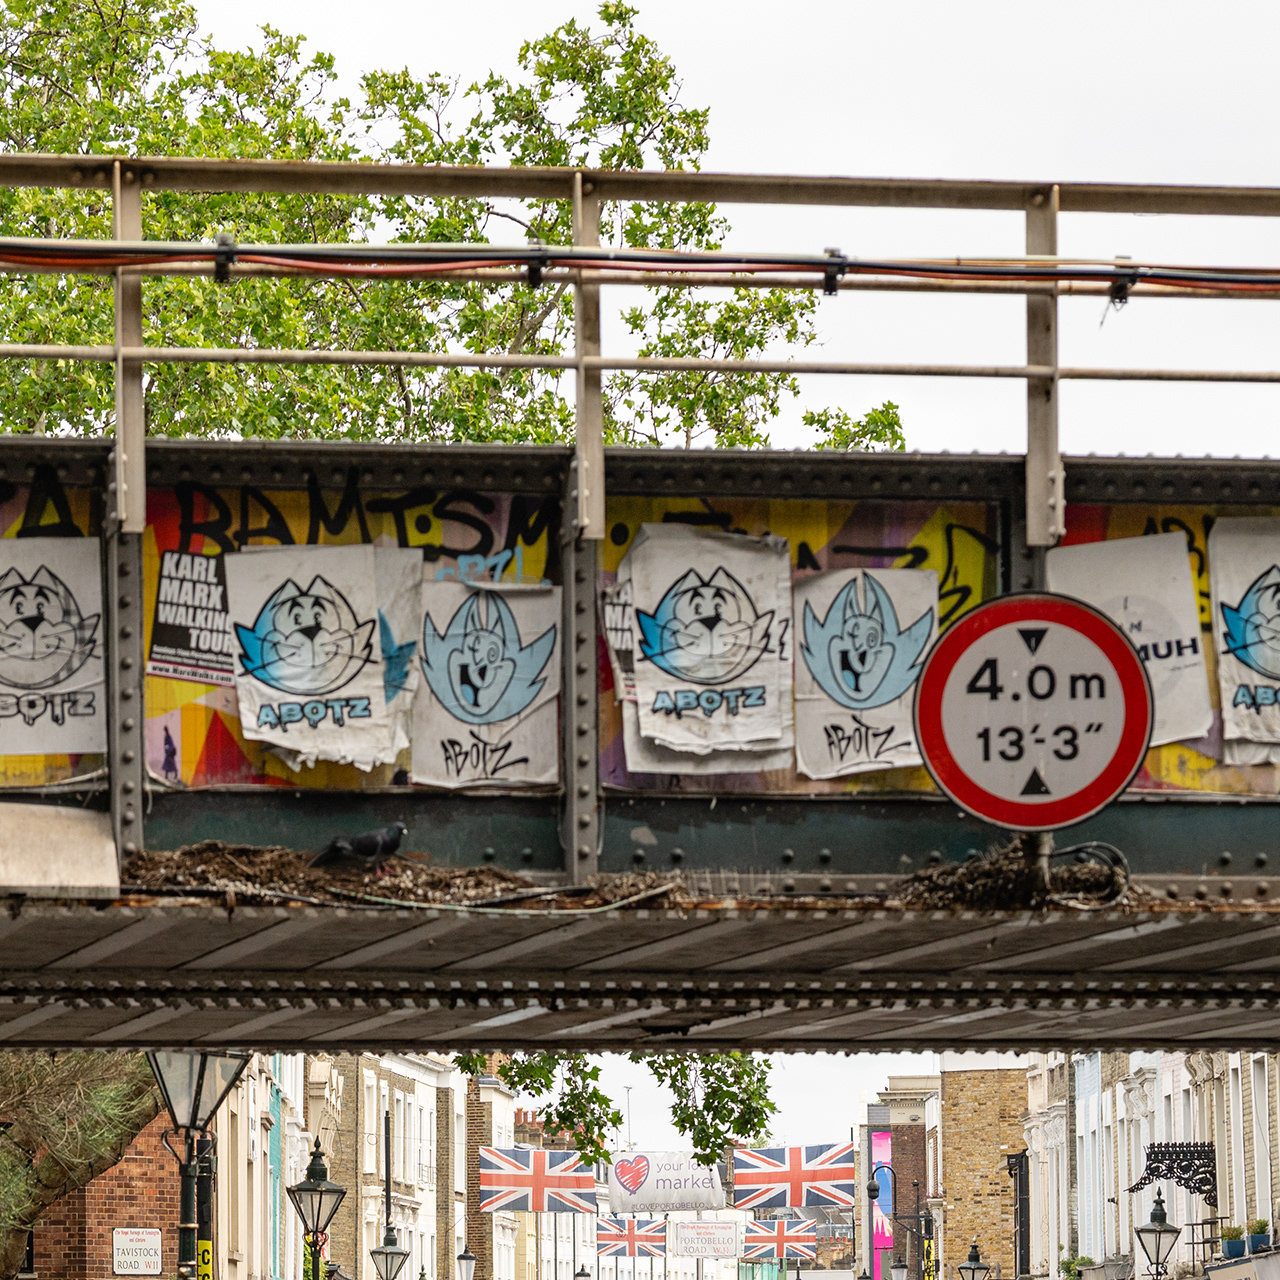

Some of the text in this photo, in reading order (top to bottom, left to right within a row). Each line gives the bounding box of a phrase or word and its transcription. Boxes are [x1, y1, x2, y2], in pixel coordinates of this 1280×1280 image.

[162, 552, 218, 583] KARL
[160, 577, 223, 610] MARX
[189, 628, 233, 653] TOUR
[967, 658, 1106, 701] 4.0 m
[257, 698, 371, 732] ABOTZ
[652, 686, 765, 720] ABOTZ
[440, 730, 528, 776] ABOTZ
[824, 716, 911, 762] ABOTZ
[656, 1161, 711, 1173] your loc
[656, 1174, 715, 1189] market
[116, 1248, 159, 1257] TAVISTOCK
[680, 1237, 733, 1245] PORTOBELLO
